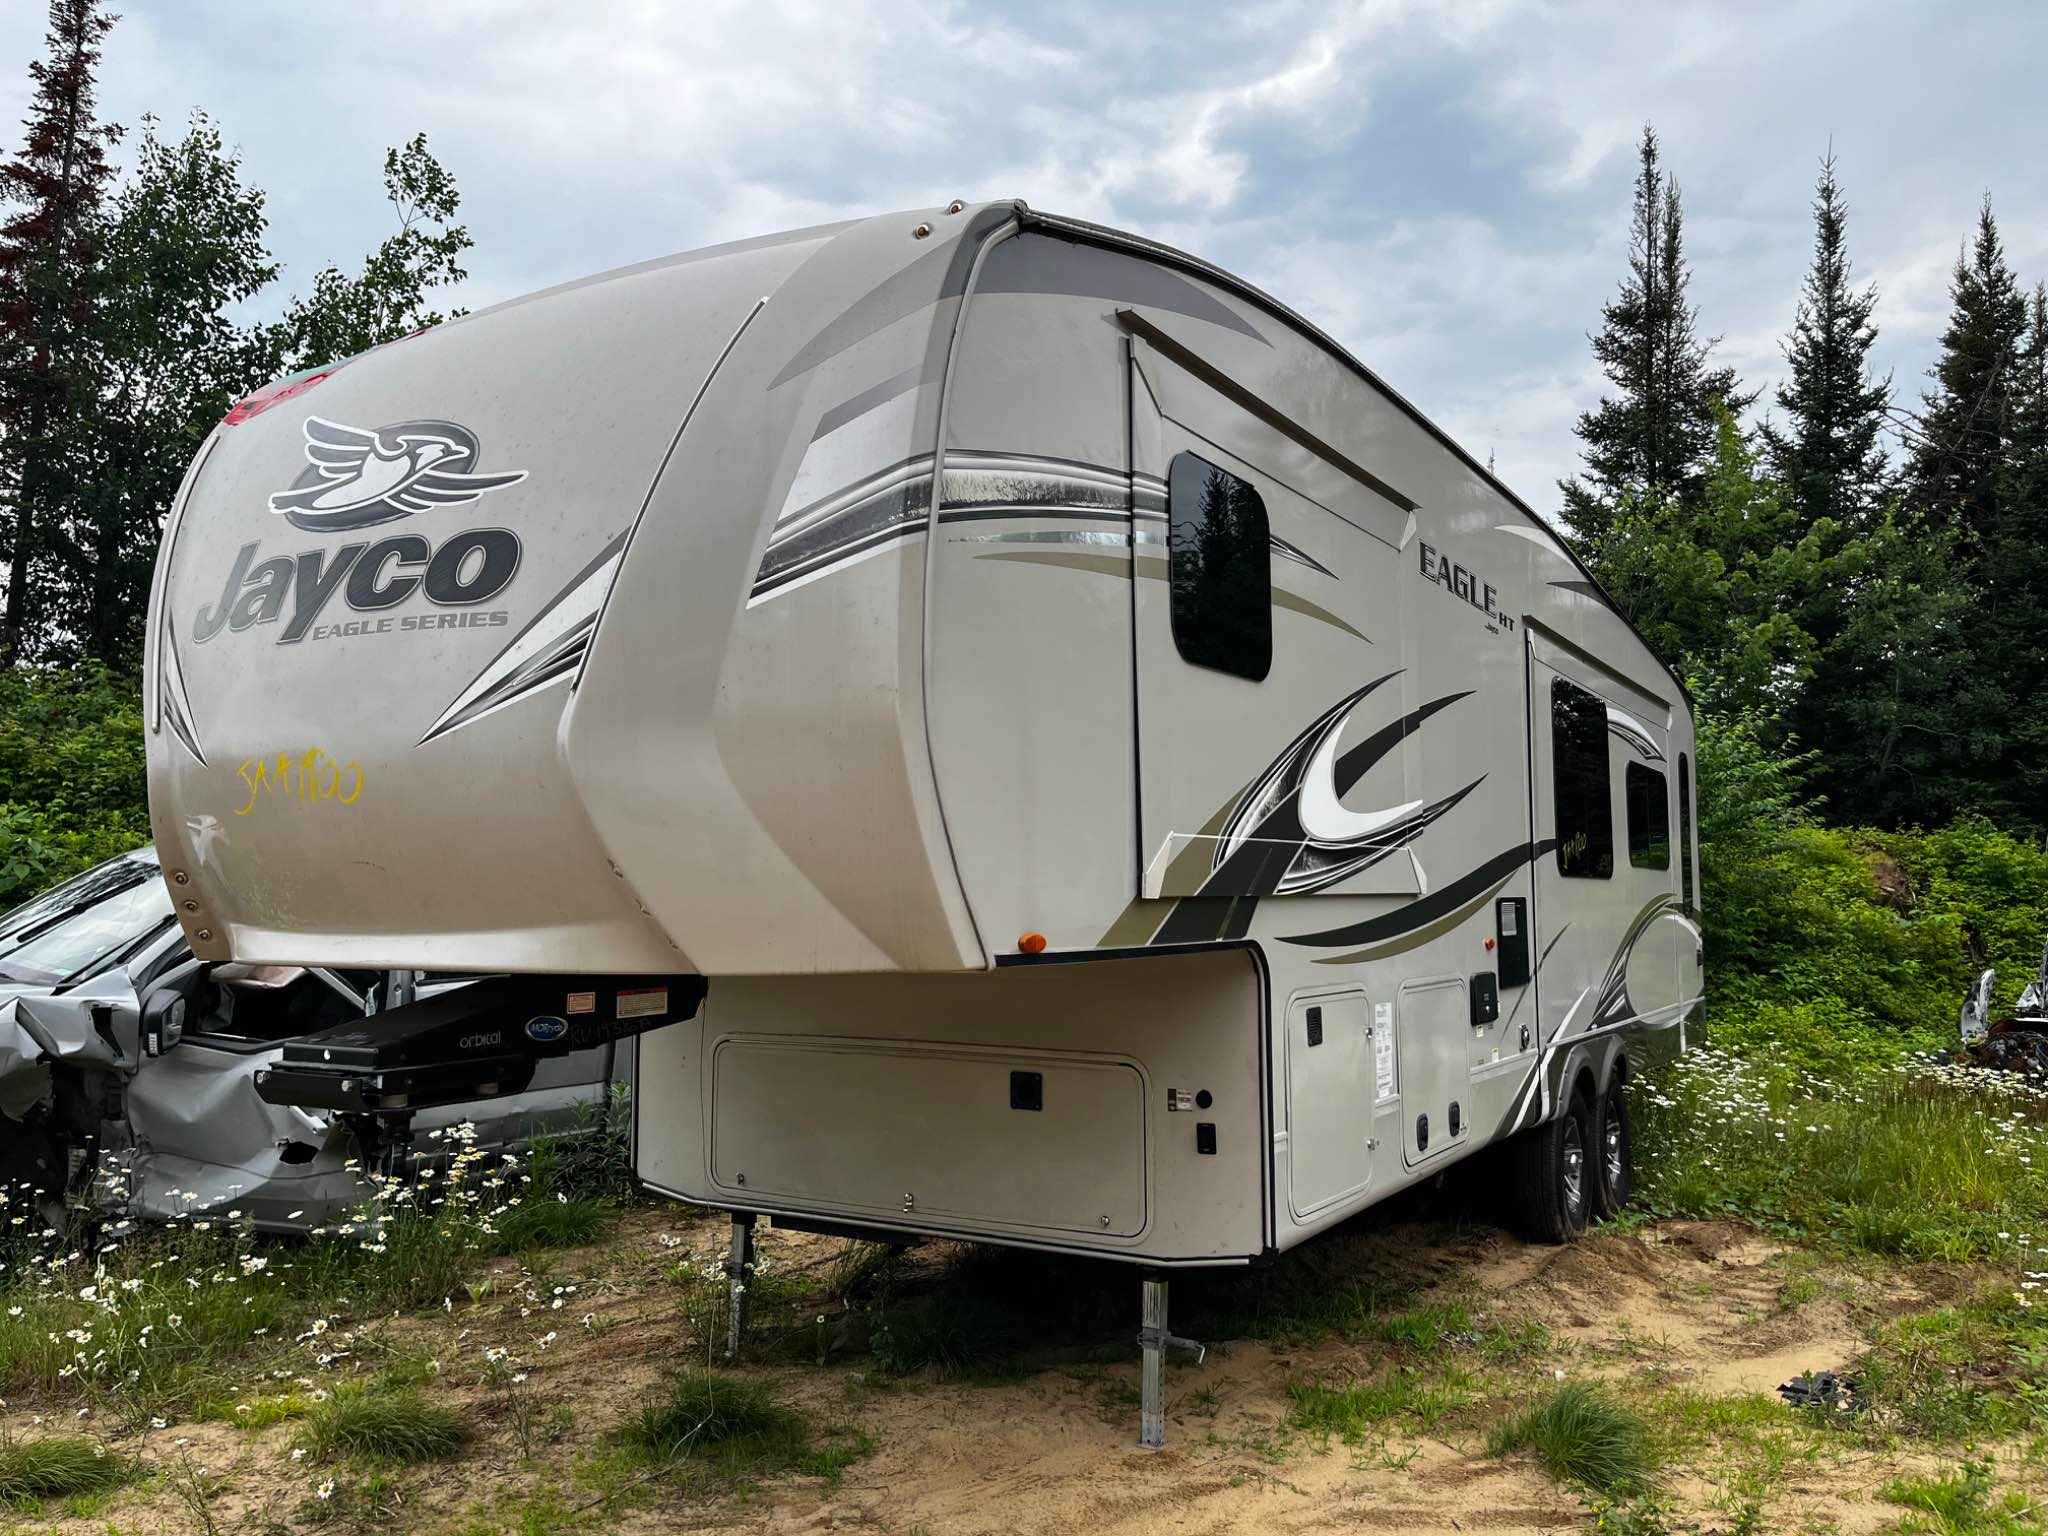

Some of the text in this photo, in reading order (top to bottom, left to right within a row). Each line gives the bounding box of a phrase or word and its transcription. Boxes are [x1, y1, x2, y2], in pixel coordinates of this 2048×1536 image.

[192, 527, 523, 645] Jayco
[313, 611, 509, 641] EAGLE SERIES
[1418, 540, 1515, 632] EAGLE HT
